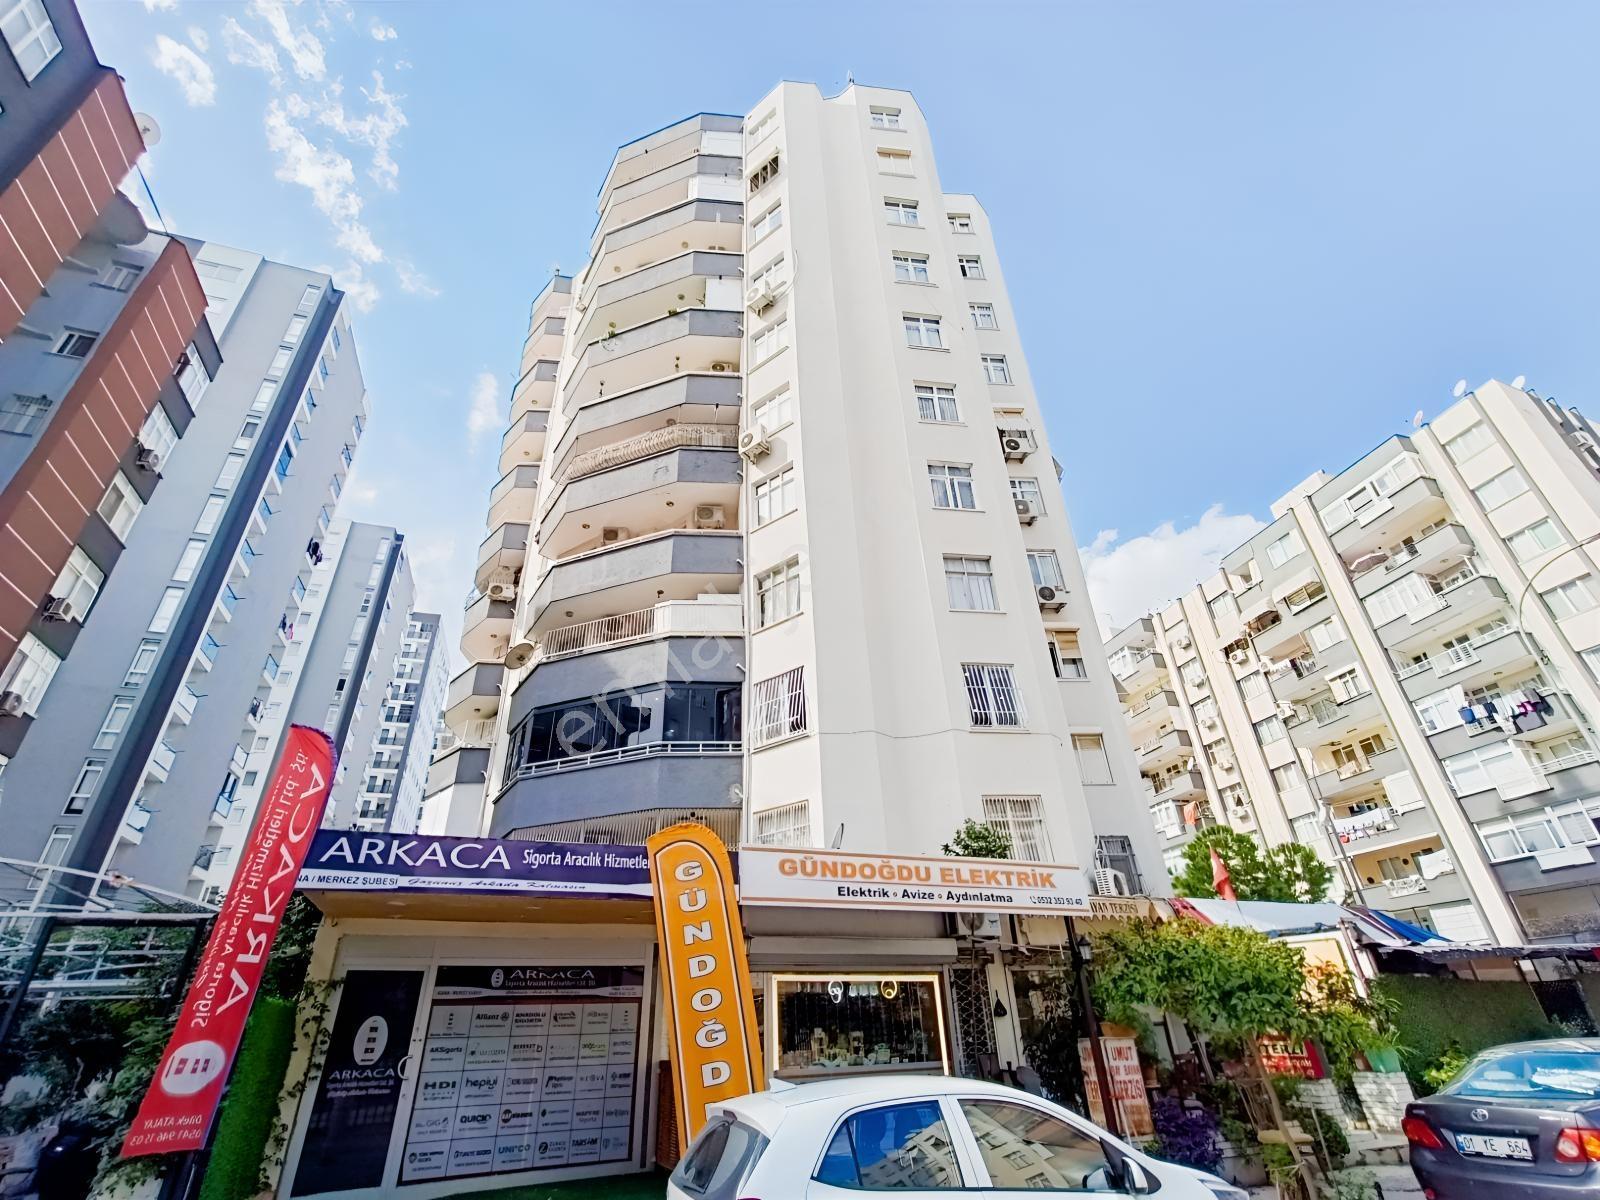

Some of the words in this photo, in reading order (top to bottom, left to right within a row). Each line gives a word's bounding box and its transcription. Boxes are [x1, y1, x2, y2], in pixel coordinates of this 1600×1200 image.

[319, 836, 511, 871] ARKACA
[522, 849, 563, 868] Sigorta
[564, 850, 602, 867] Aracılık
[317, 875, 360, 885] MERKEZ
[778, 857, 931, 883] GÜNDOĞDU
[940, 867, 1057, 889] ELEKTRİK
[837, 885, 890, 899] Elektrik
[901, 888, 935, 901] Avize
[946, 889, 1014, 904] Aydınlatma
[674, 860, 736, 1120] GÜNDOĞD
[329, 1068, 395, 1080] ARKACA
[1463, 1137, 1475, 1150] 01
[1484, 1138, 1498, 1152] YE
